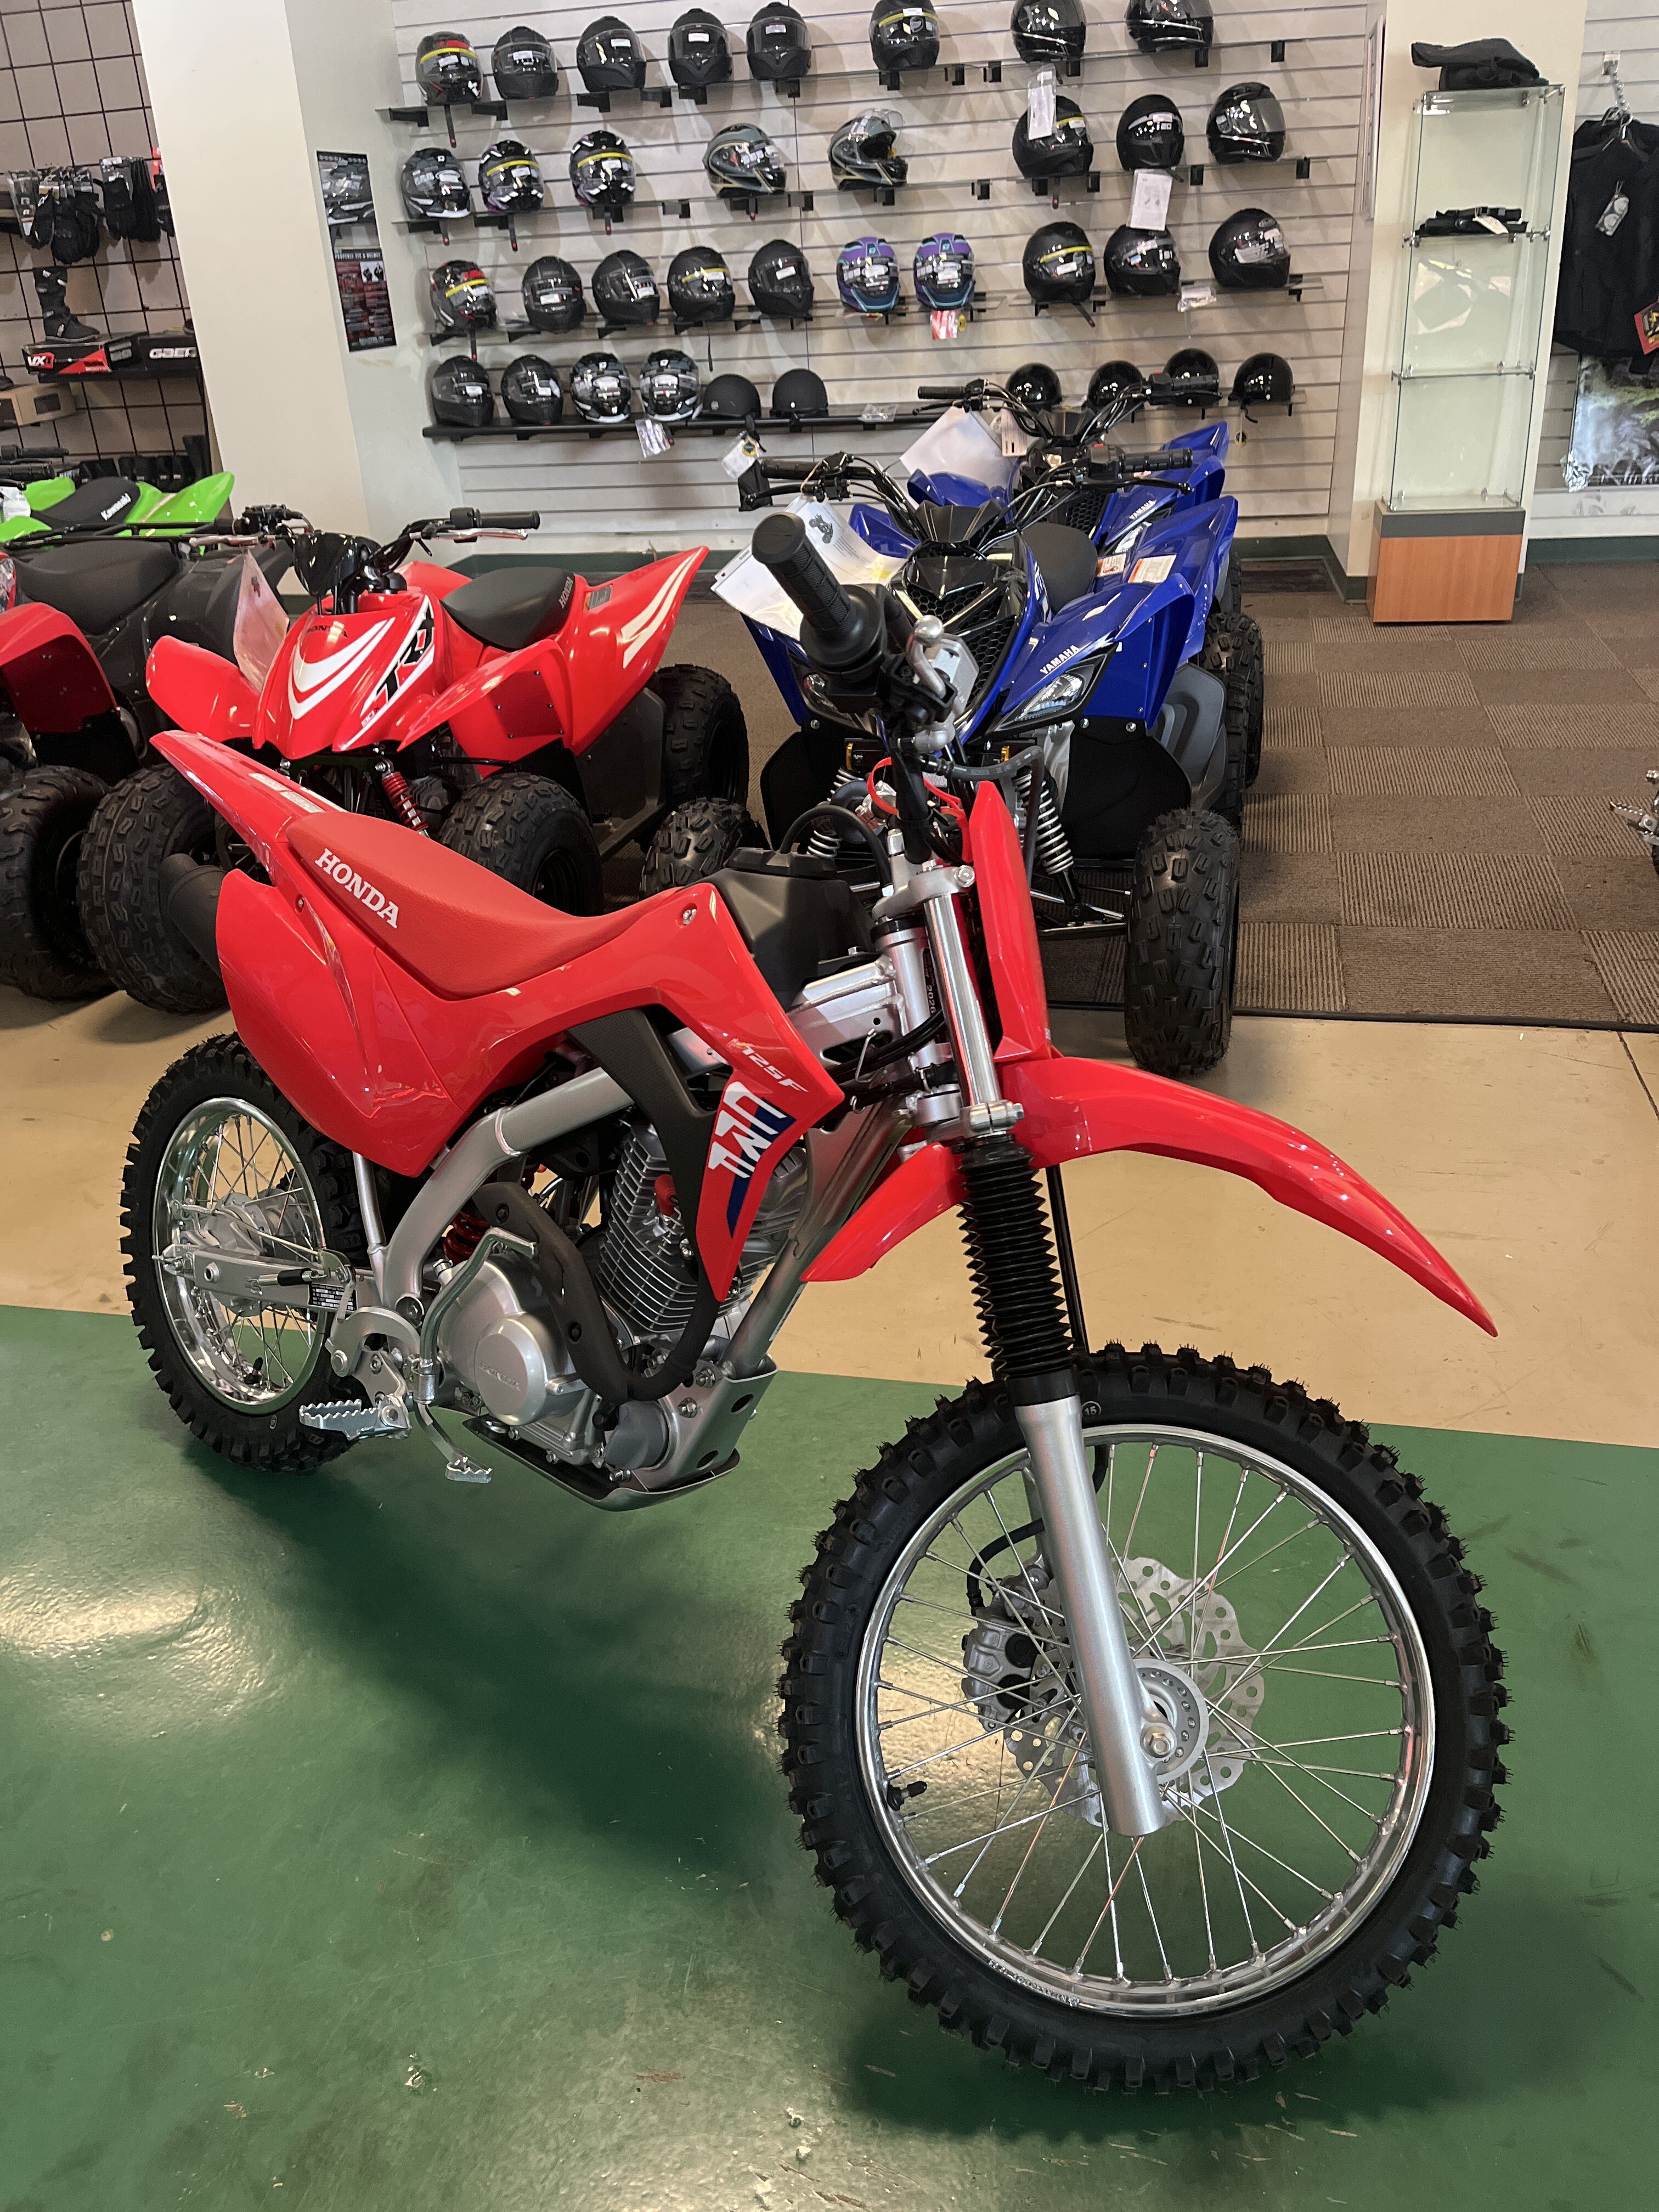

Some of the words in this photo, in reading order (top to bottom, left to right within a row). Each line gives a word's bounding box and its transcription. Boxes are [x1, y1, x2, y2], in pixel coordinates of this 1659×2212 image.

[1129, 500, 1157, 520] YAMAHA
[1039, 645, 1081, 675] YAMAHA
[314, 848, 399, 929] HONDA
[742, 1046, 809, 1093] 125F
[1084, 1406, 1097, 1415] 15
